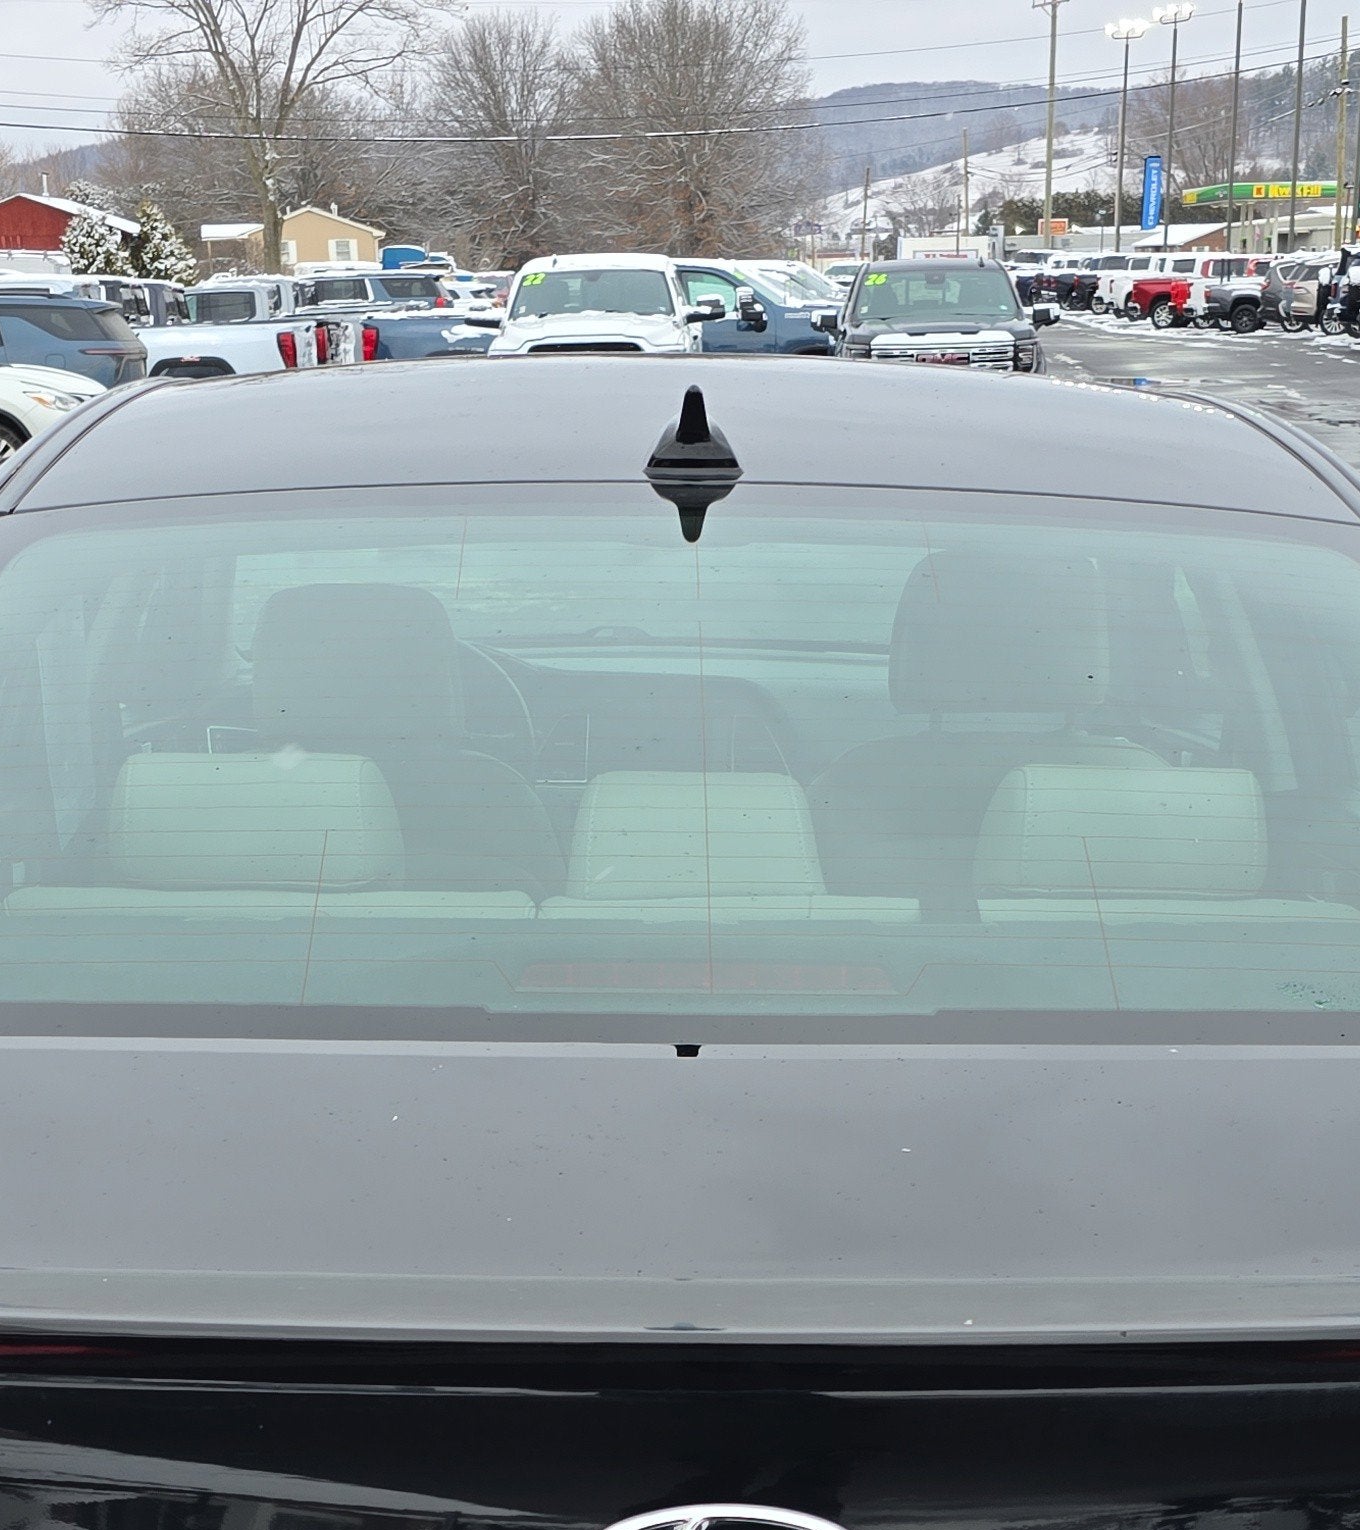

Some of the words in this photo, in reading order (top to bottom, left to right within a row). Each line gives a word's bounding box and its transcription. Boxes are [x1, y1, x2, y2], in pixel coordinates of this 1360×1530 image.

[1147, 169, 1159, 226] CHEVROLET
[522, 272, 546, 287] 22
[863, 273, 890, 286] 26
